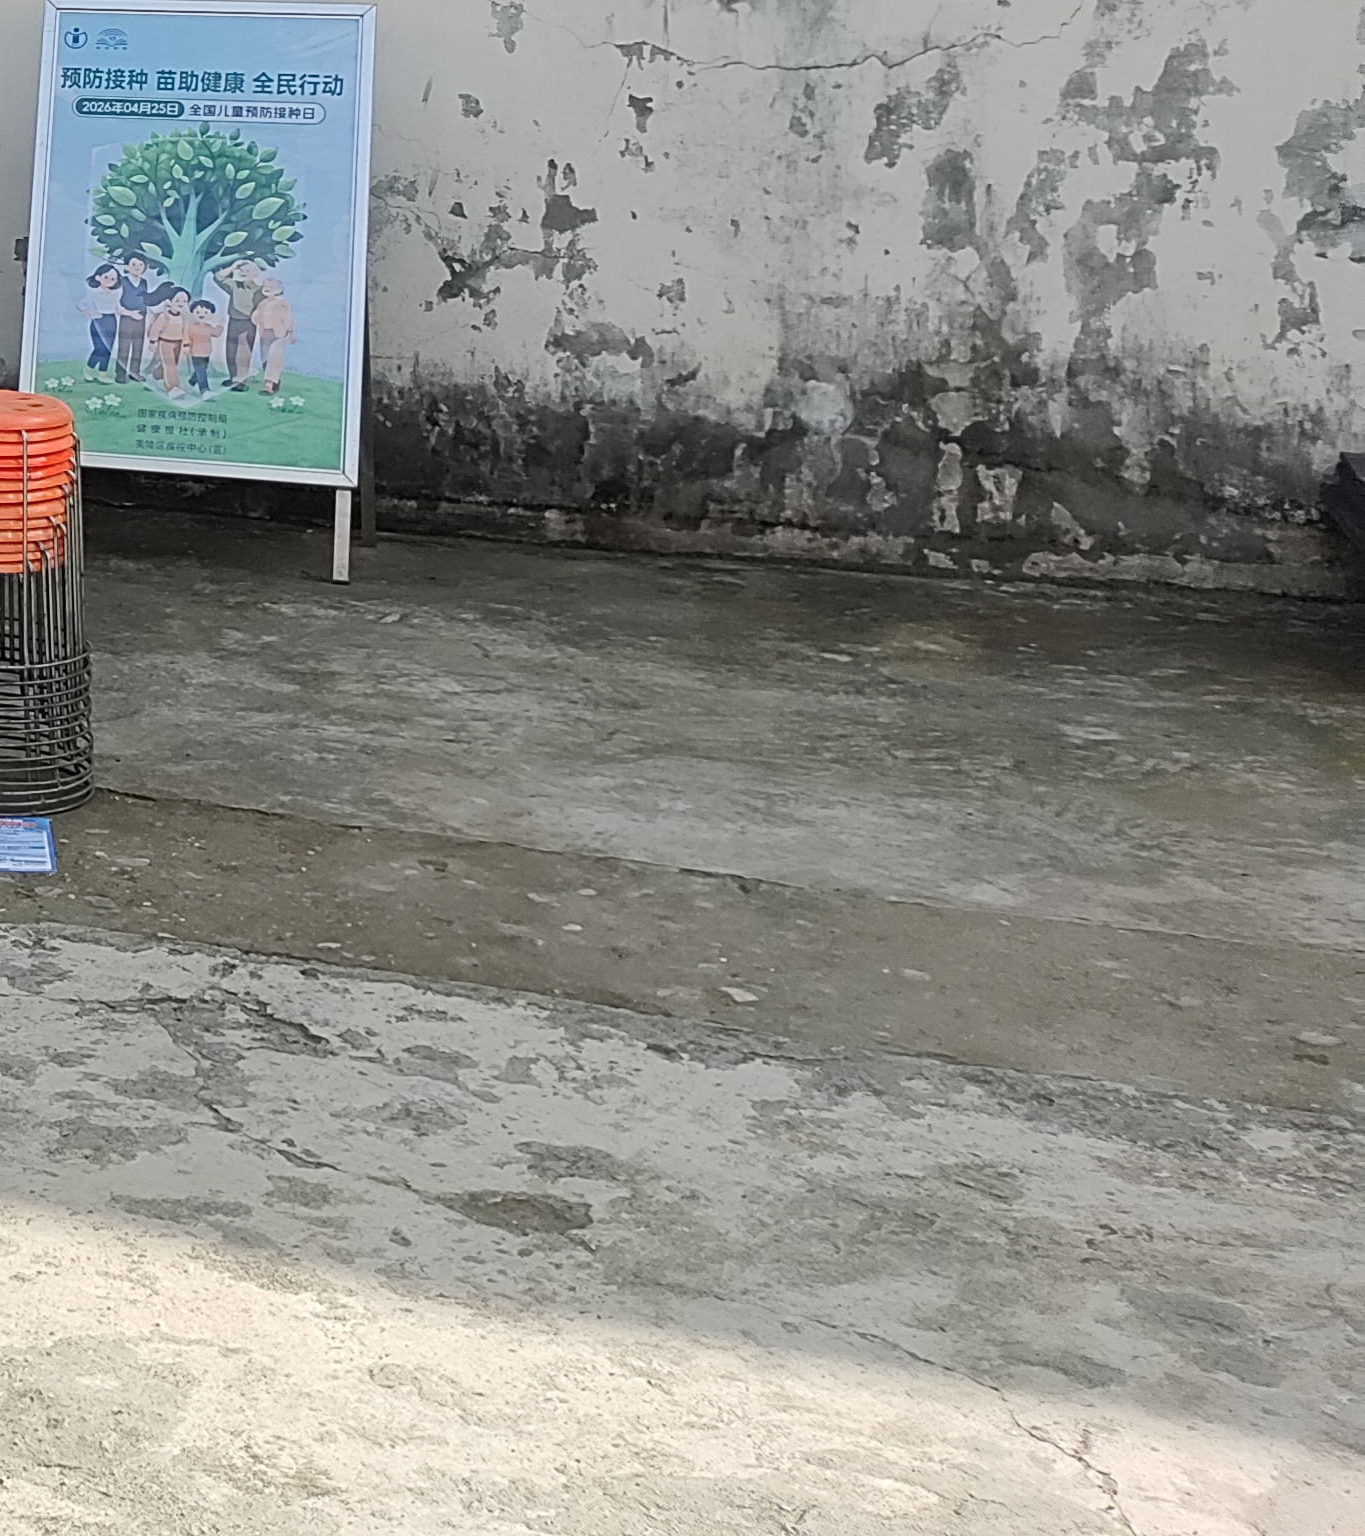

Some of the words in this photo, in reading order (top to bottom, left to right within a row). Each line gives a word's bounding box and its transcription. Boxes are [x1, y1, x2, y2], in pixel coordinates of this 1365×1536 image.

[60, 67, 149, 90] 预防接种
[155, 69, 246, 94] 苗助健康
[252, 72, 344, 98] 全民行动
[82, 100, 179, 116] 2026年04月25日
[188, 102, 316, 120] 全国儿童预防接种日
